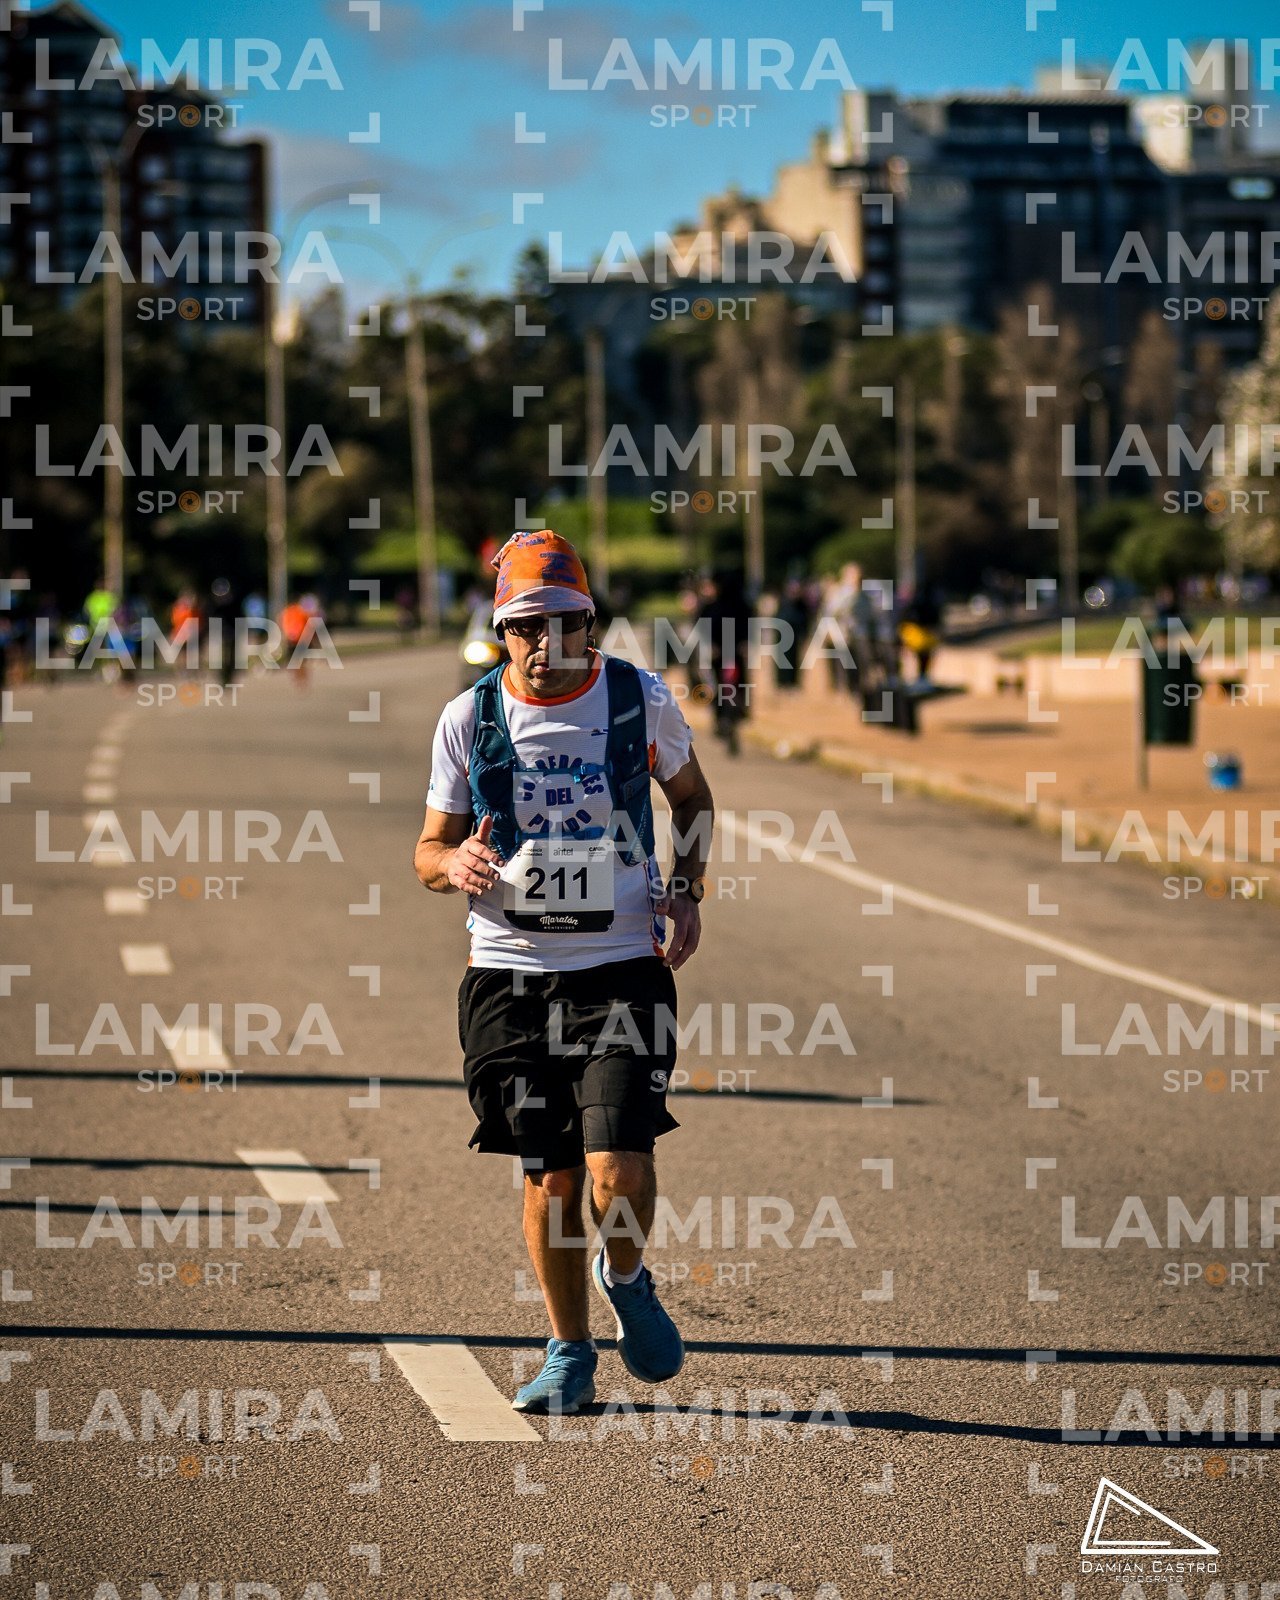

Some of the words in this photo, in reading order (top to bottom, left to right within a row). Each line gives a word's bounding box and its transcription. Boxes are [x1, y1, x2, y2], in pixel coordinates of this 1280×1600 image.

[545, 787, 574, 806] DEL
[553, 847, 573, 857] antel
[525, 866, 587, 900] 211
[539, 915, 579, 926] Maratón
